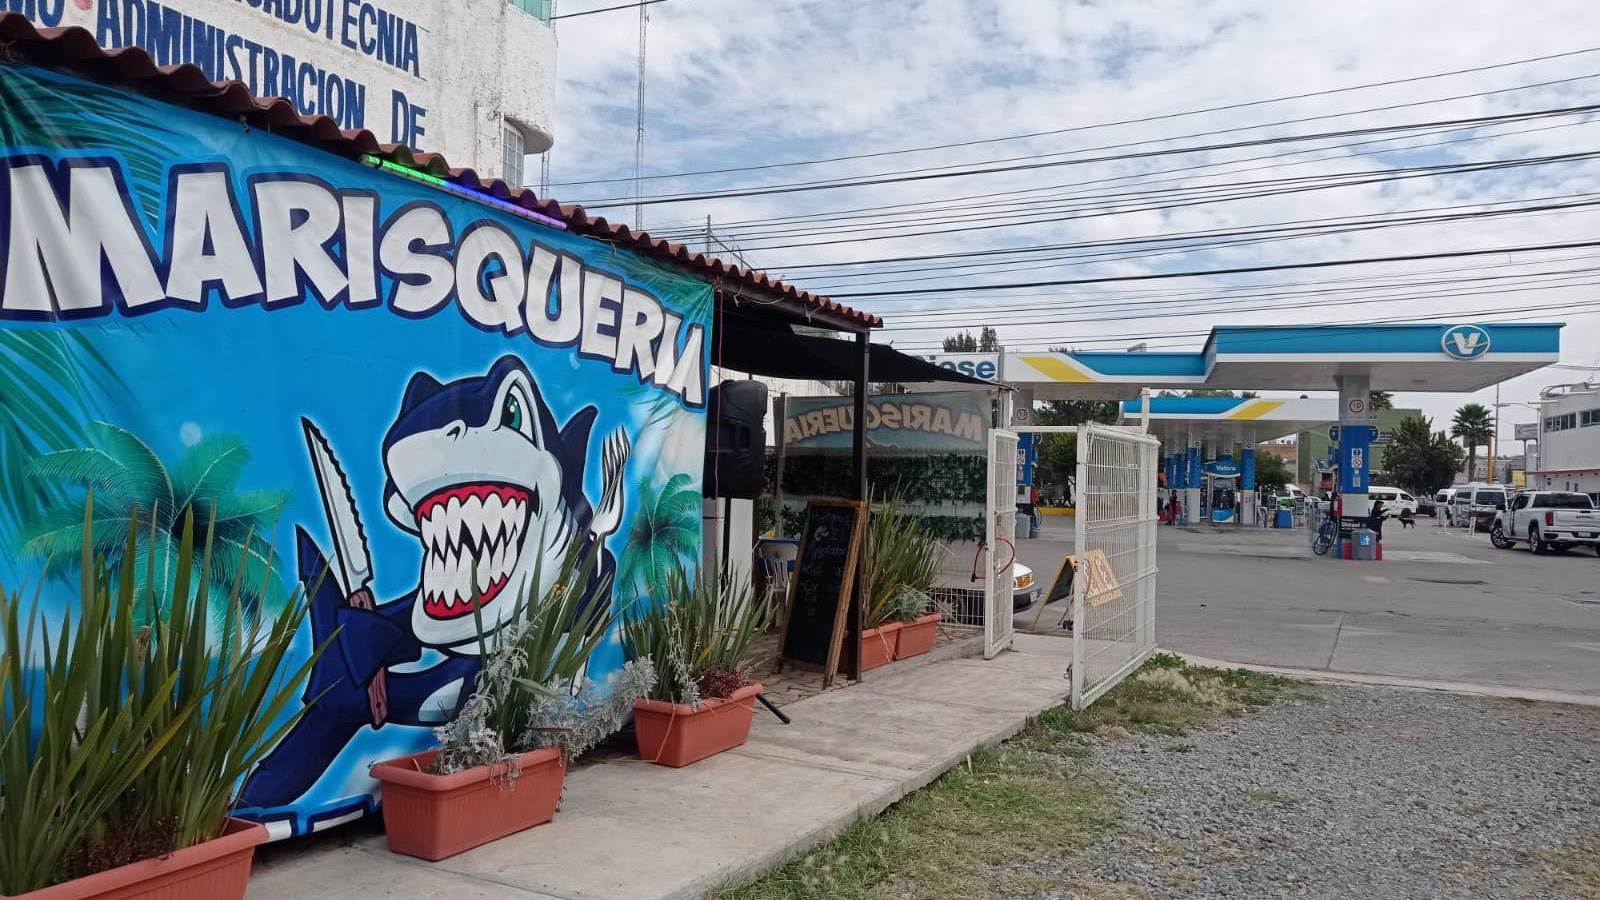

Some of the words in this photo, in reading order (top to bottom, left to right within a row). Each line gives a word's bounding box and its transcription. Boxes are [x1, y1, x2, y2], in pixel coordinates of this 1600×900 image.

[96, 0, 366, 130] ADMINISTRACION
[391, 89, 426, 153] DE
[1, 162, 704, 405] MARISQUERIA
